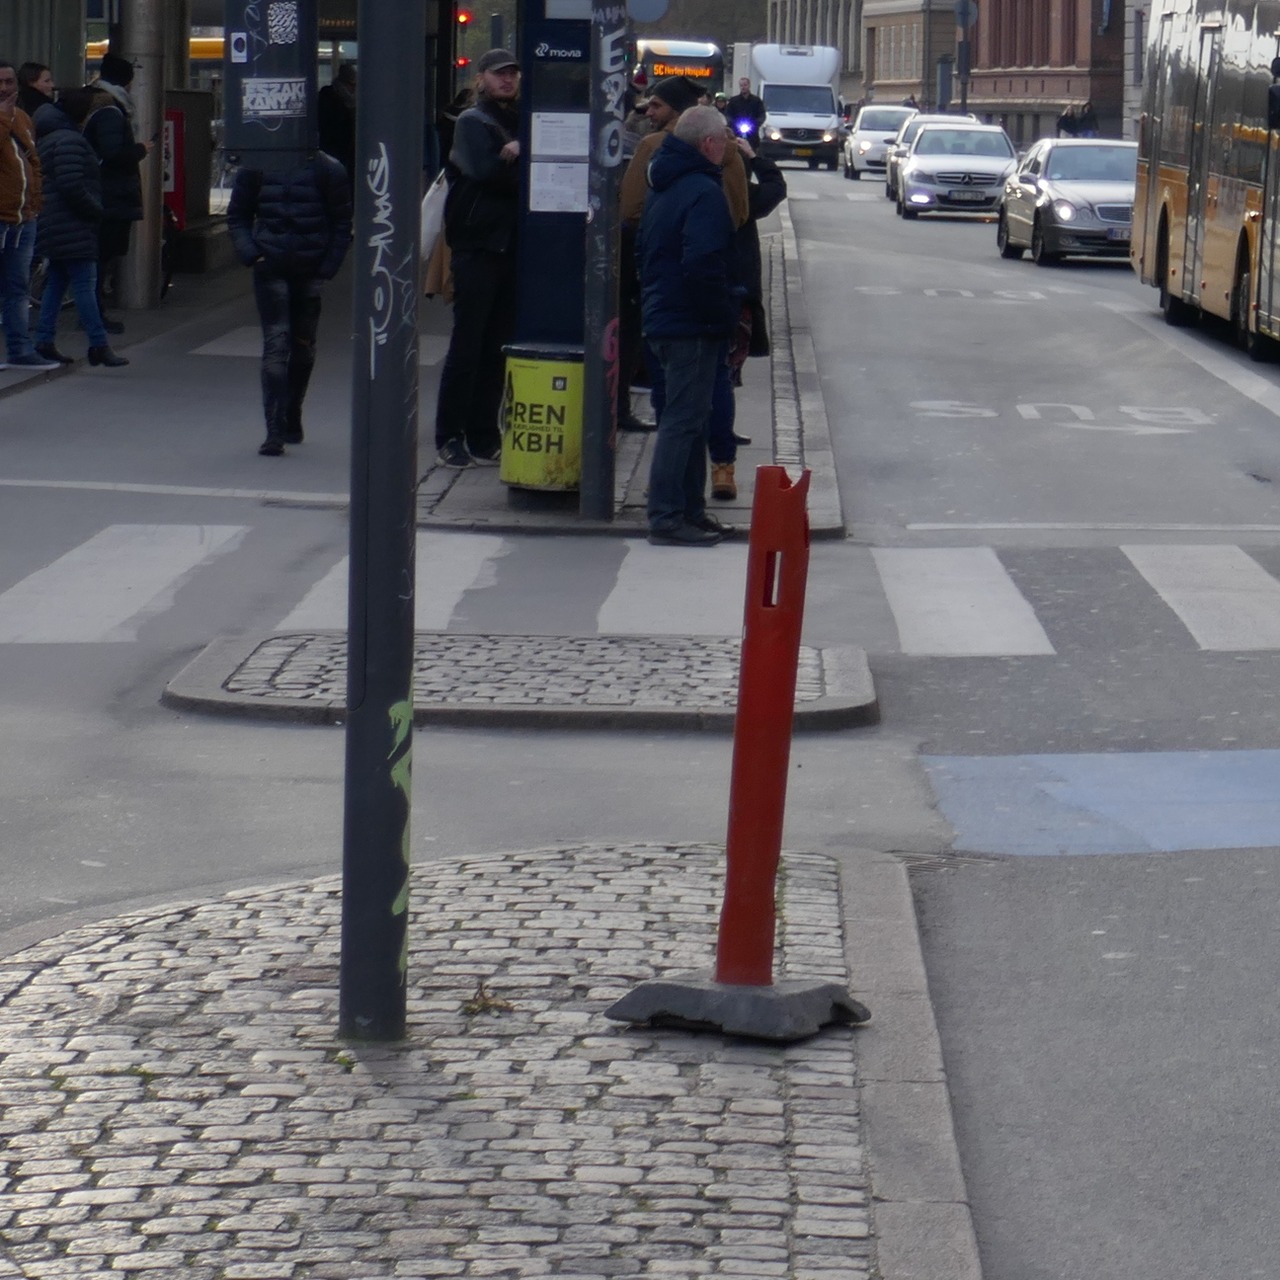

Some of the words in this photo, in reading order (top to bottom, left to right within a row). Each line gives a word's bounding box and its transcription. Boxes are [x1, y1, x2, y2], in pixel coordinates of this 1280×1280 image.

[549, 48, 582, 58] movia
[653, 63, 664, 76] 5C
[514, 402, 566, 426] REN
[512, 431, 564, 455] KBH
